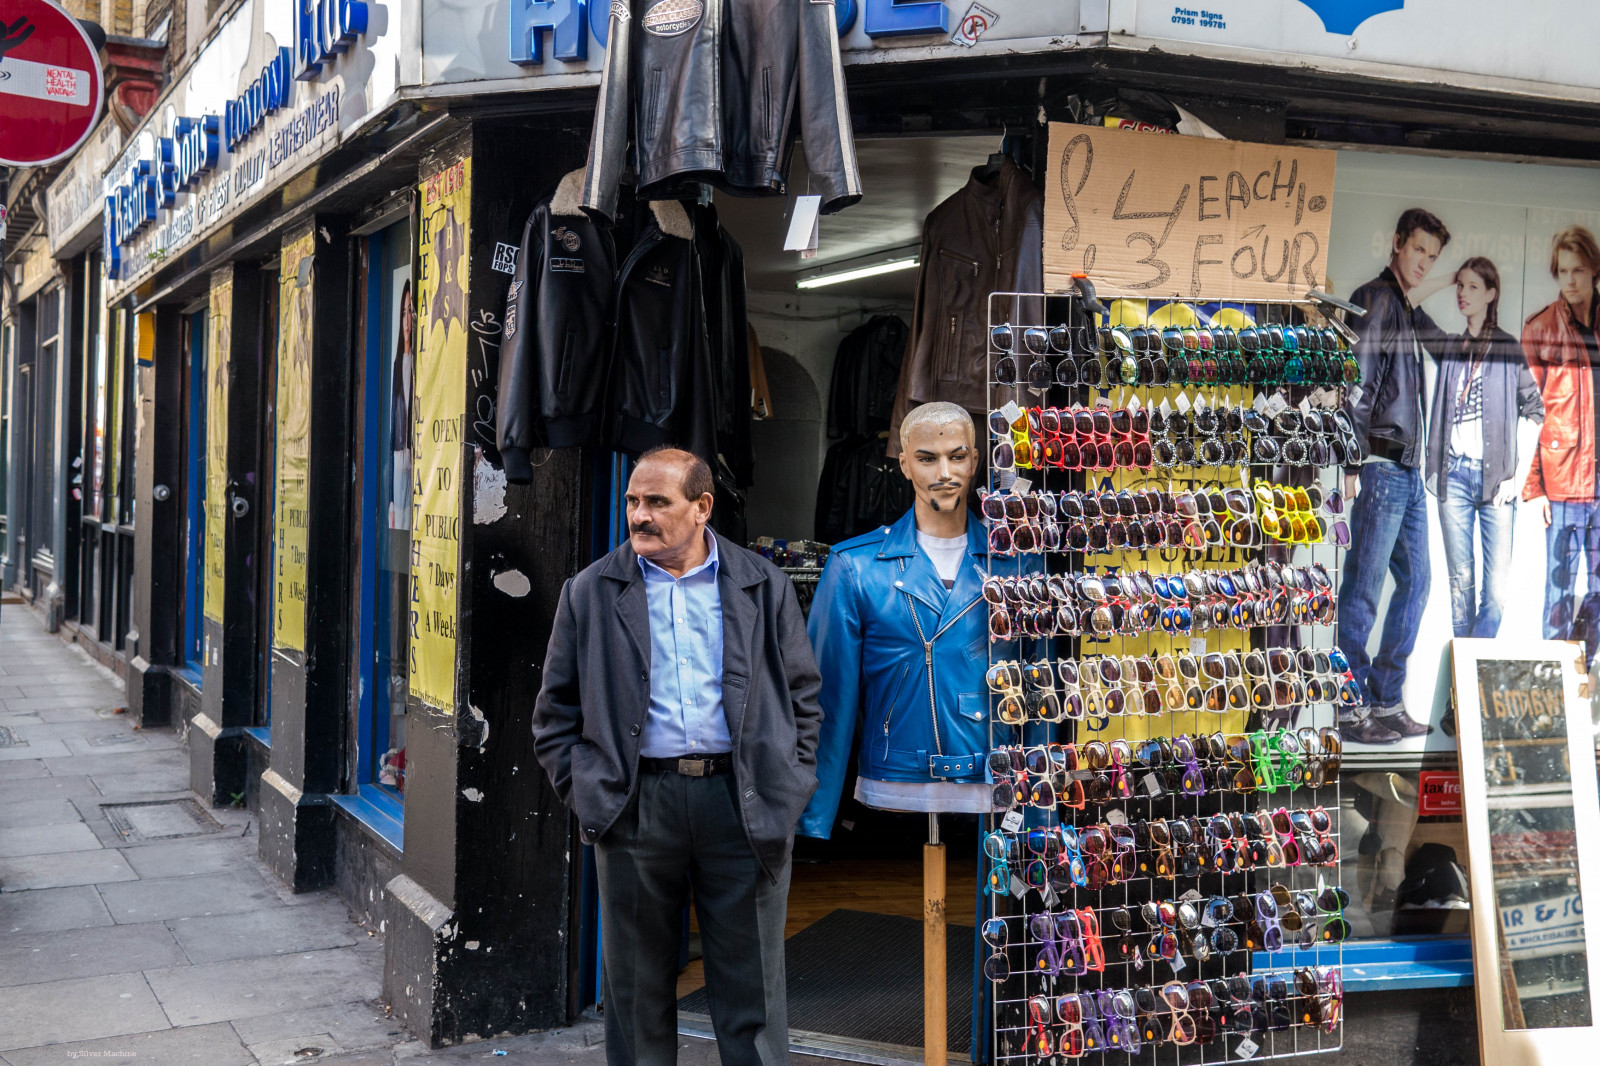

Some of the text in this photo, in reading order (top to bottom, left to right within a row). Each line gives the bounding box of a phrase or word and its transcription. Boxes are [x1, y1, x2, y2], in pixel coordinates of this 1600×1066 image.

[656, 20, 692, 31] motorcycles
[1171, 15, 1195, 25] 07951
[1175, 7, 1223, 20] Prism Signs
[46, 67, 77, 80] MENTAL
[46, 79, 77, 90] HEALTH
[234, 147, 266, 199] QUALITY
[268, 83, 340, 170] LEATHERWEAR
[156, 137, 177, 209] &
[171, 115, 219, 193] Sons
[427, 171, 442, 205] EST
[1199, 158, 1298, 221] EACH
[494, 261, 514, 273] FOPS
[1190, 230, 1318, 298] FOUR
[432, 418, 459, 443] OPEN
[437, 467, 451, 491] TO
[425, 514, 459, 541] PUBLIC
[295, 546, 306, 569] Days
[429, 561, 454, 596] 7 Days
[425, 611, 456, 640] A Week
